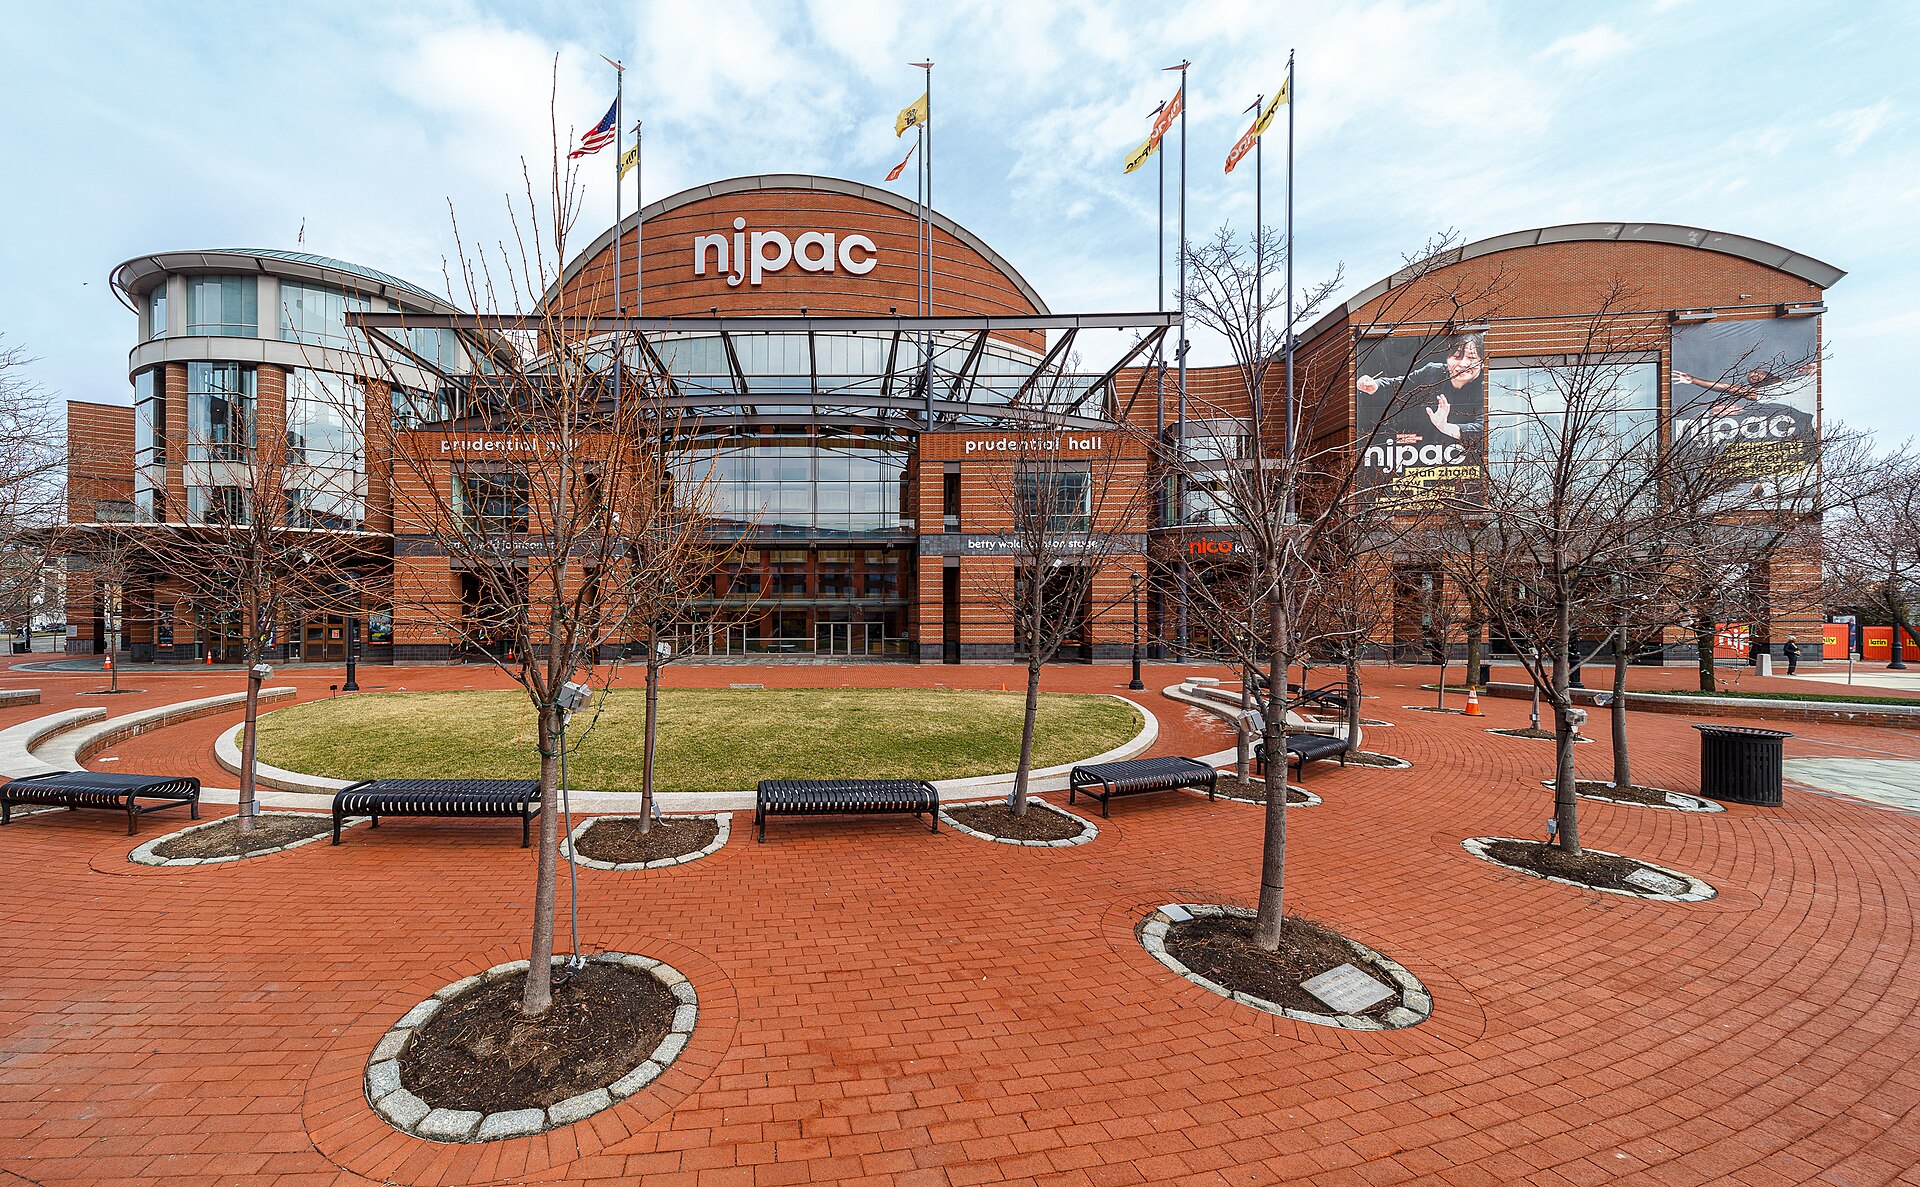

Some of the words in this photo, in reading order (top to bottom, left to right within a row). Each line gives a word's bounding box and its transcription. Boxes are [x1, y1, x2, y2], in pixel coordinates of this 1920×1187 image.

[694, 217, 878, 287] njpac
[965, 437, 1059, 454] prudential
[1068, 436, 1101, 450] hall
[1364, 439, 1467, 474] njpac
[967, 539, 996, 551] betty
[1189, 537, 1233, 554] nico
[1869, 638, 1887, 646] latin
